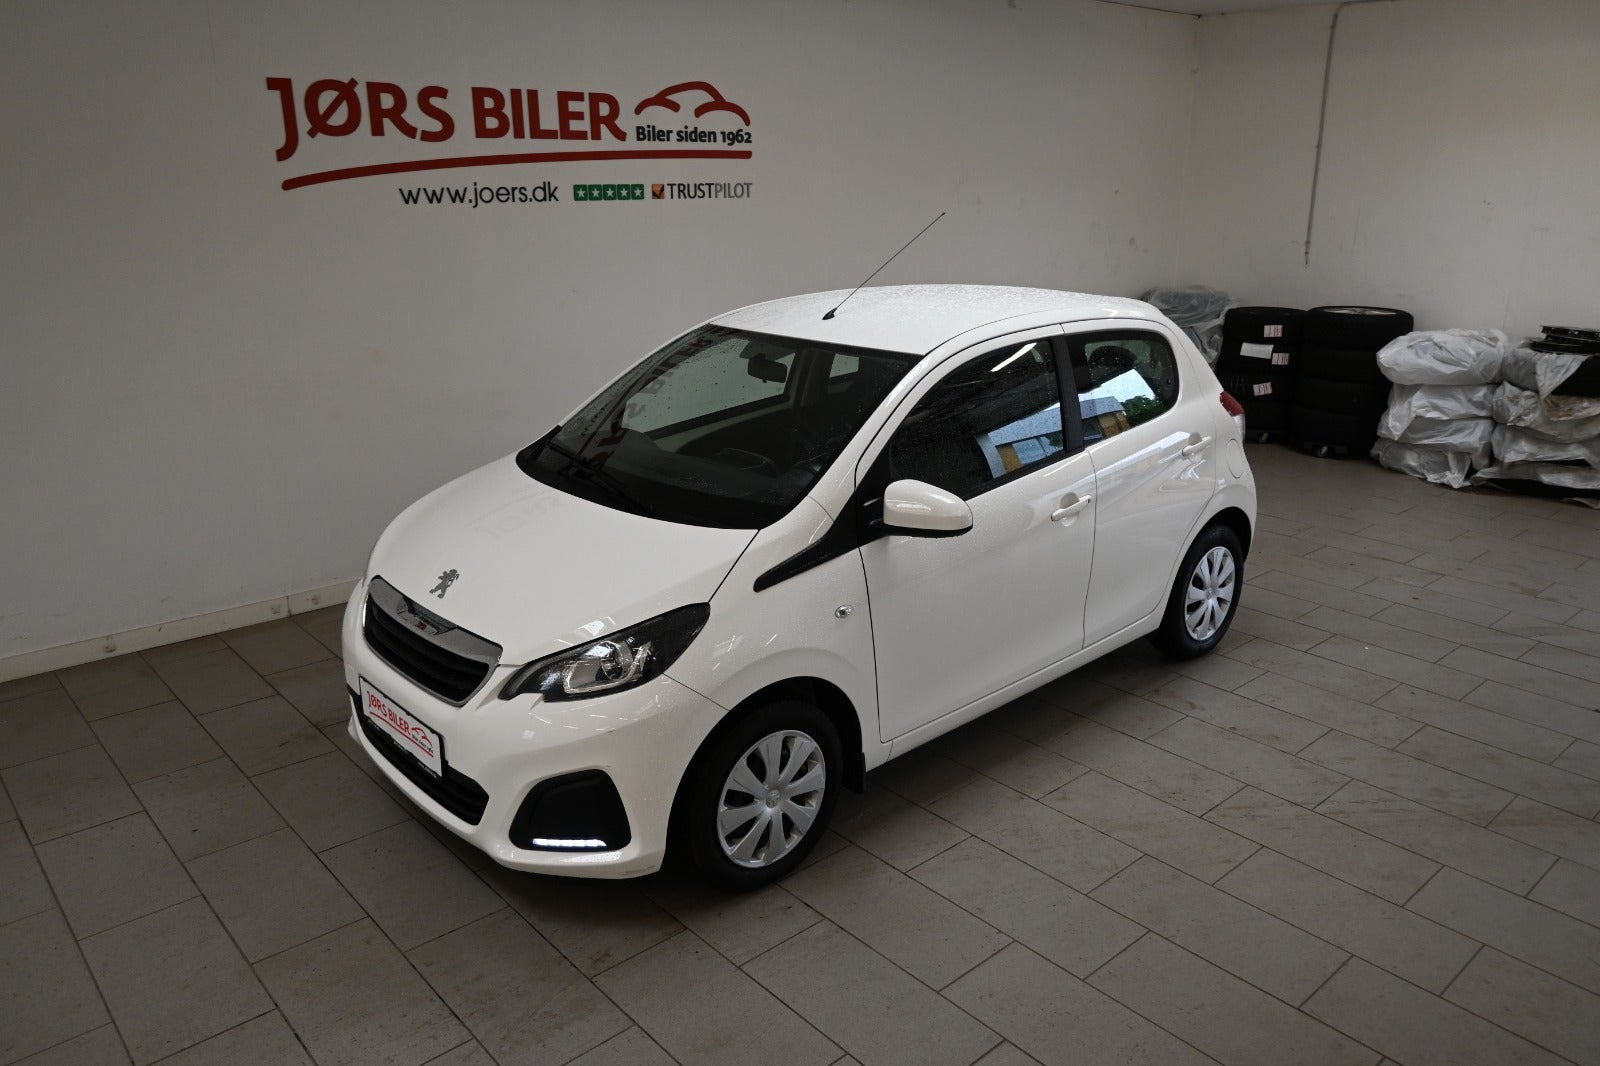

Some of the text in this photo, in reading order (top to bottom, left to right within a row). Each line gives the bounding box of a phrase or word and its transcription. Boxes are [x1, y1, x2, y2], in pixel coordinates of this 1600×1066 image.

[266, 77, 627, 162] JØRS BILER
[636, 125, 753, 146] Biler siden 1962
[398, 181, 560, 208] www.joers.dk
[667, 182, 753, 199] TRUSTPILOT
[388, 709, 411, 736] BILER
